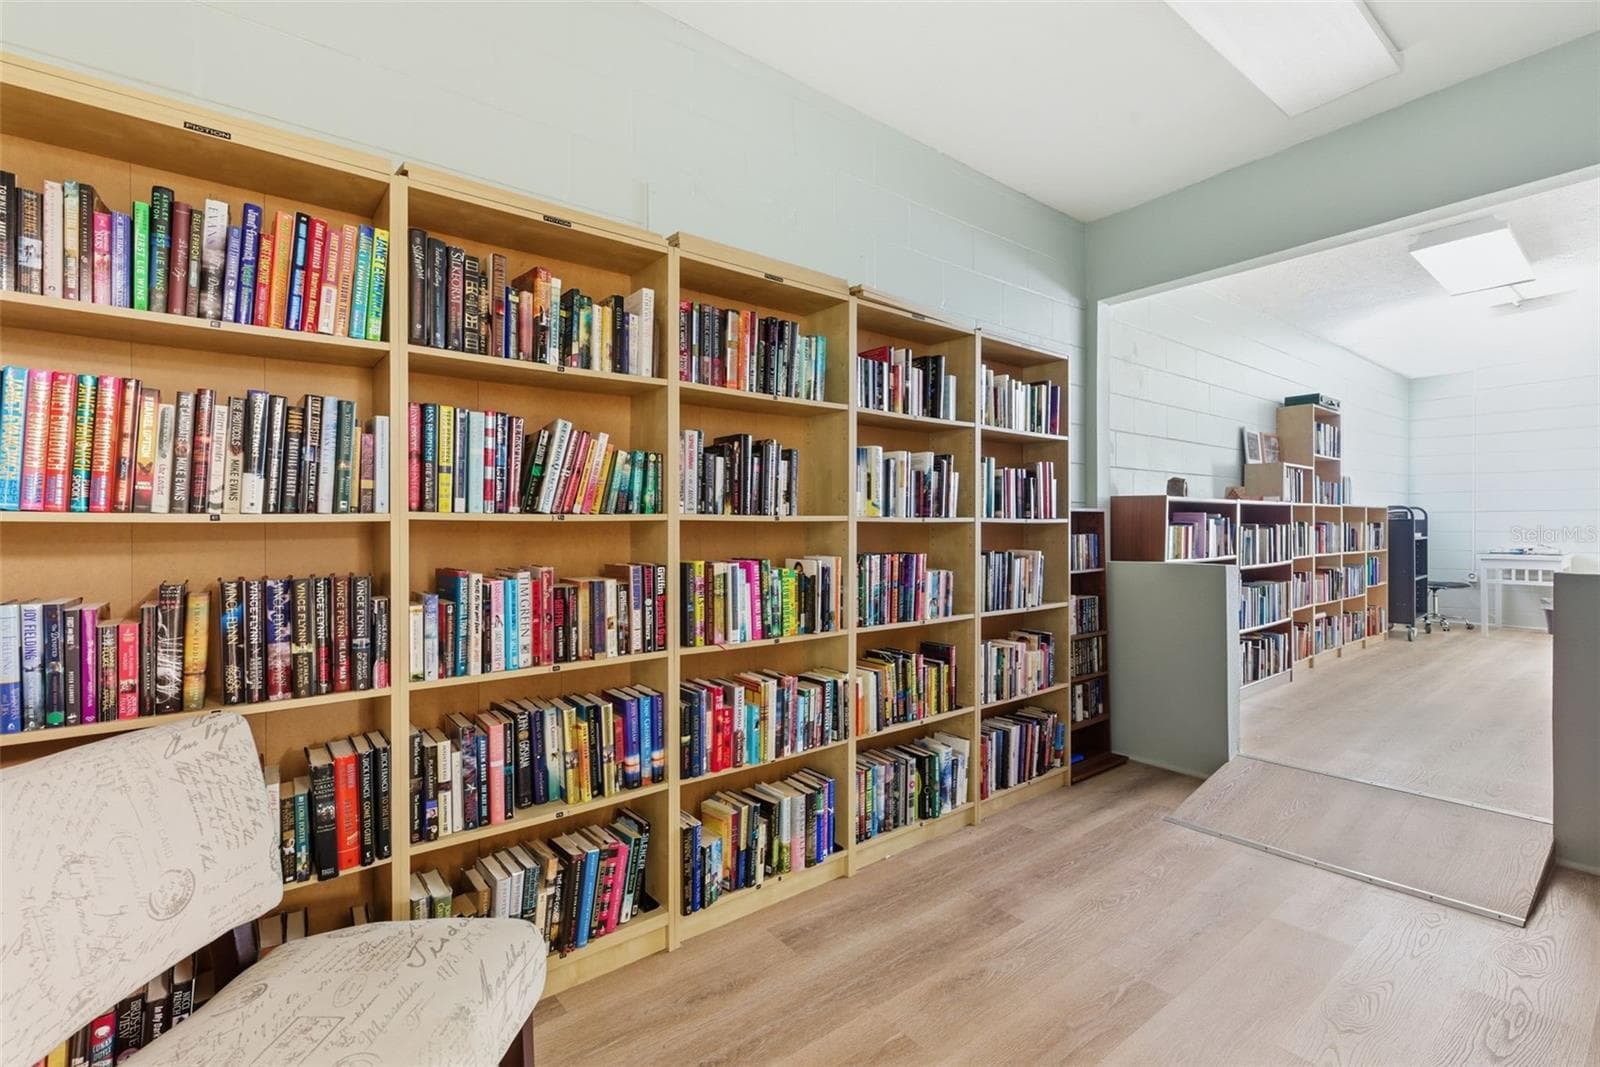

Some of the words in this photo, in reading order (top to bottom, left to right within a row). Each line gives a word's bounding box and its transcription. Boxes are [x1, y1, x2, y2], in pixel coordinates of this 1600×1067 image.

[297, 583, 305, 612] VINCE
[316, 582, 324, 609] VINCE
[336, 581, 344, 608] VINCE
[356, 580, 364, 607] VINCE
[520, 576, 530, 598] TIM
[24, 609, 37, 622] JOY
[298, 613, 307, 642] FLYNN
[316, 610, 325, 639] FLYNN
[336, 610, 345, 637] FLYNN
[357, 609, 365, 637] FLYNN
[520, 599, 530, 638] GREEN
[24, 624, 37, 661] FIELDING
[362, 758, 370, 774] DICK
[380, 752, 388, 768] DICK
[363, 774, 371, 798] FRANCIS
[381, 769, 389, 793] FRANCIS
[638, 832, 650, 870] SILENCER
